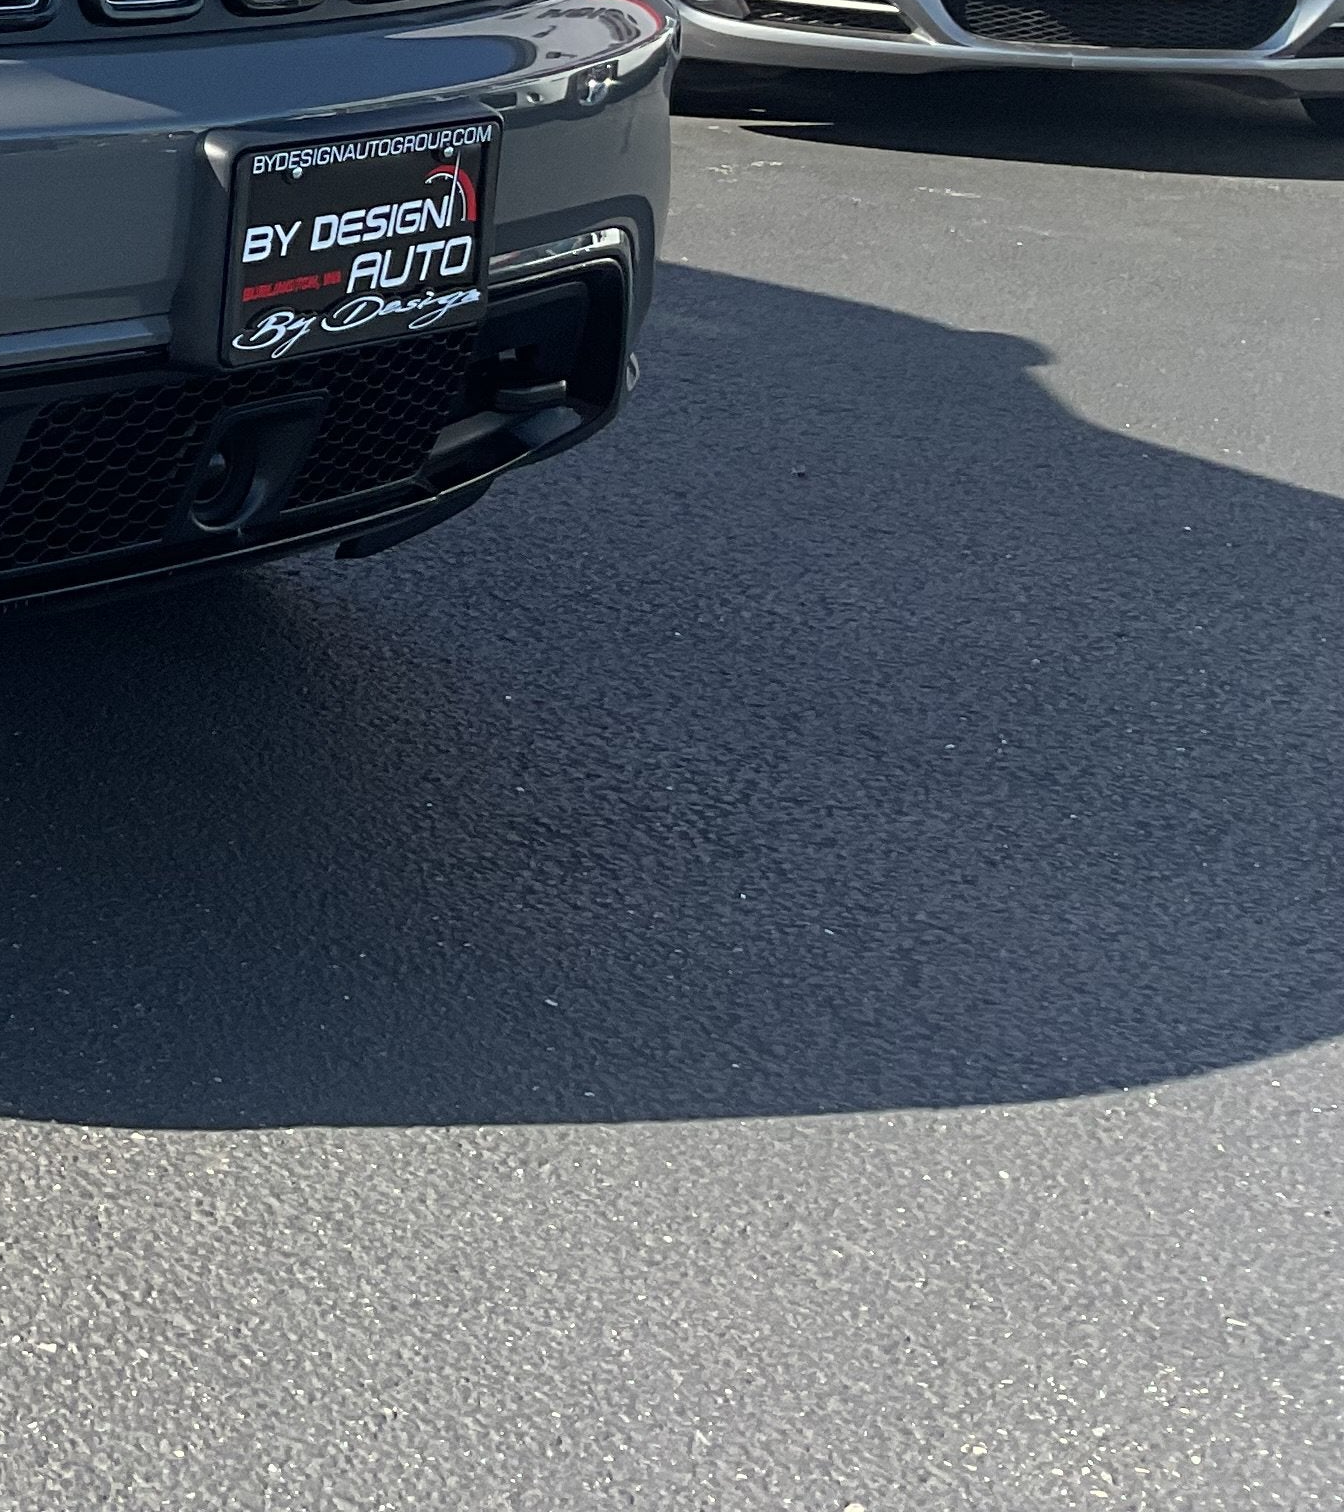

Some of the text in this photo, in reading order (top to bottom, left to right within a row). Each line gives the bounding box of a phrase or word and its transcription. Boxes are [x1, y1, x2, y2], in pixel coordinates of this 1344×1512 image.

[252, 125, 492, 174] BYDESIGNAUTOGROUP.COM
[242, 195, 451, 263] BY DESIGN
[346, 236, 472, 294] AUTO
[231, 288, 481, 359] By Design
